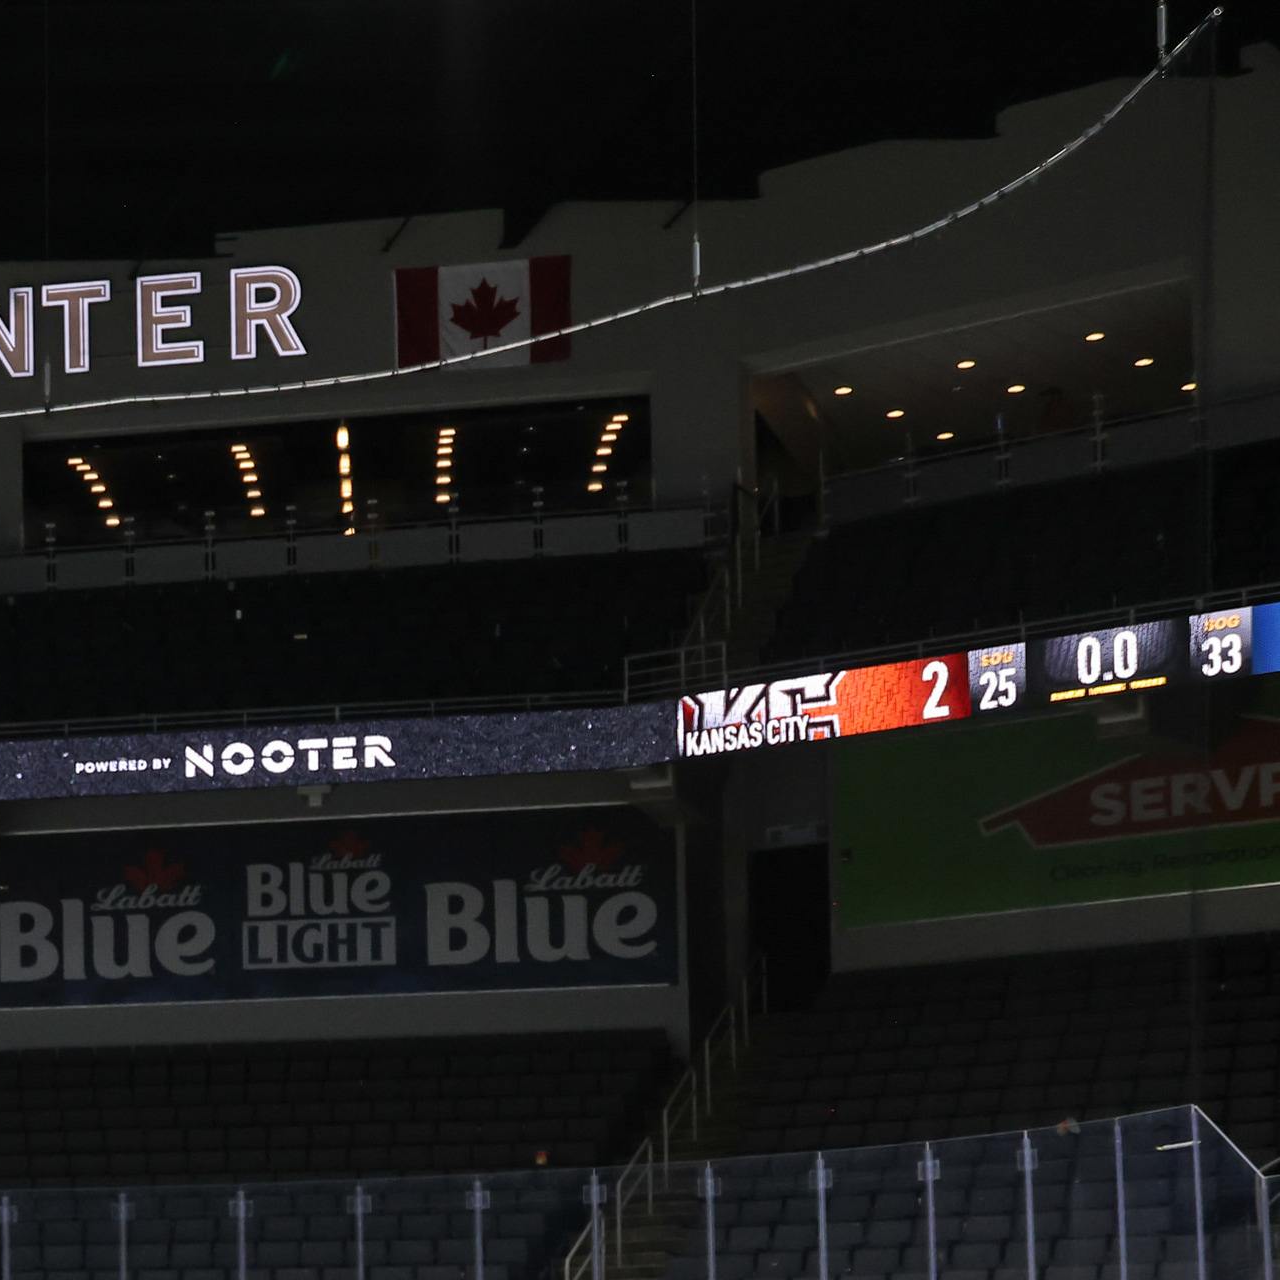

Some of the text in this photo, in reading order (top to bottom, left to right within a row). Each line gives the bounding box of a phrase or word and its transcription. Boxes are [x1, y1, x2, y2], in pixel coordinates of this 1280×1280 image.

[1076, 630, 1139, 686] 0.0
[1200, 633, 1243, 677] 33
[920, 660, 951, 721] 2
[978, 667, 1017, 711] 25
[183, 735, 397, 779] NOOTER
[685, 713, 811, 757] KANSAS CITY
[75, 757, 172, 775] POWERED BY
[1087, 763, 1280, 827] SERVP
[309, 853, 383, 871] Labatt
[529, 866, 645, 893] Labatt
[90, 884, 202, 912] Labatt
[244, 862, 392, 919] Blue
[246, 920, 394, 966] LIGHT
[426, 877, 660, 967] Blue
